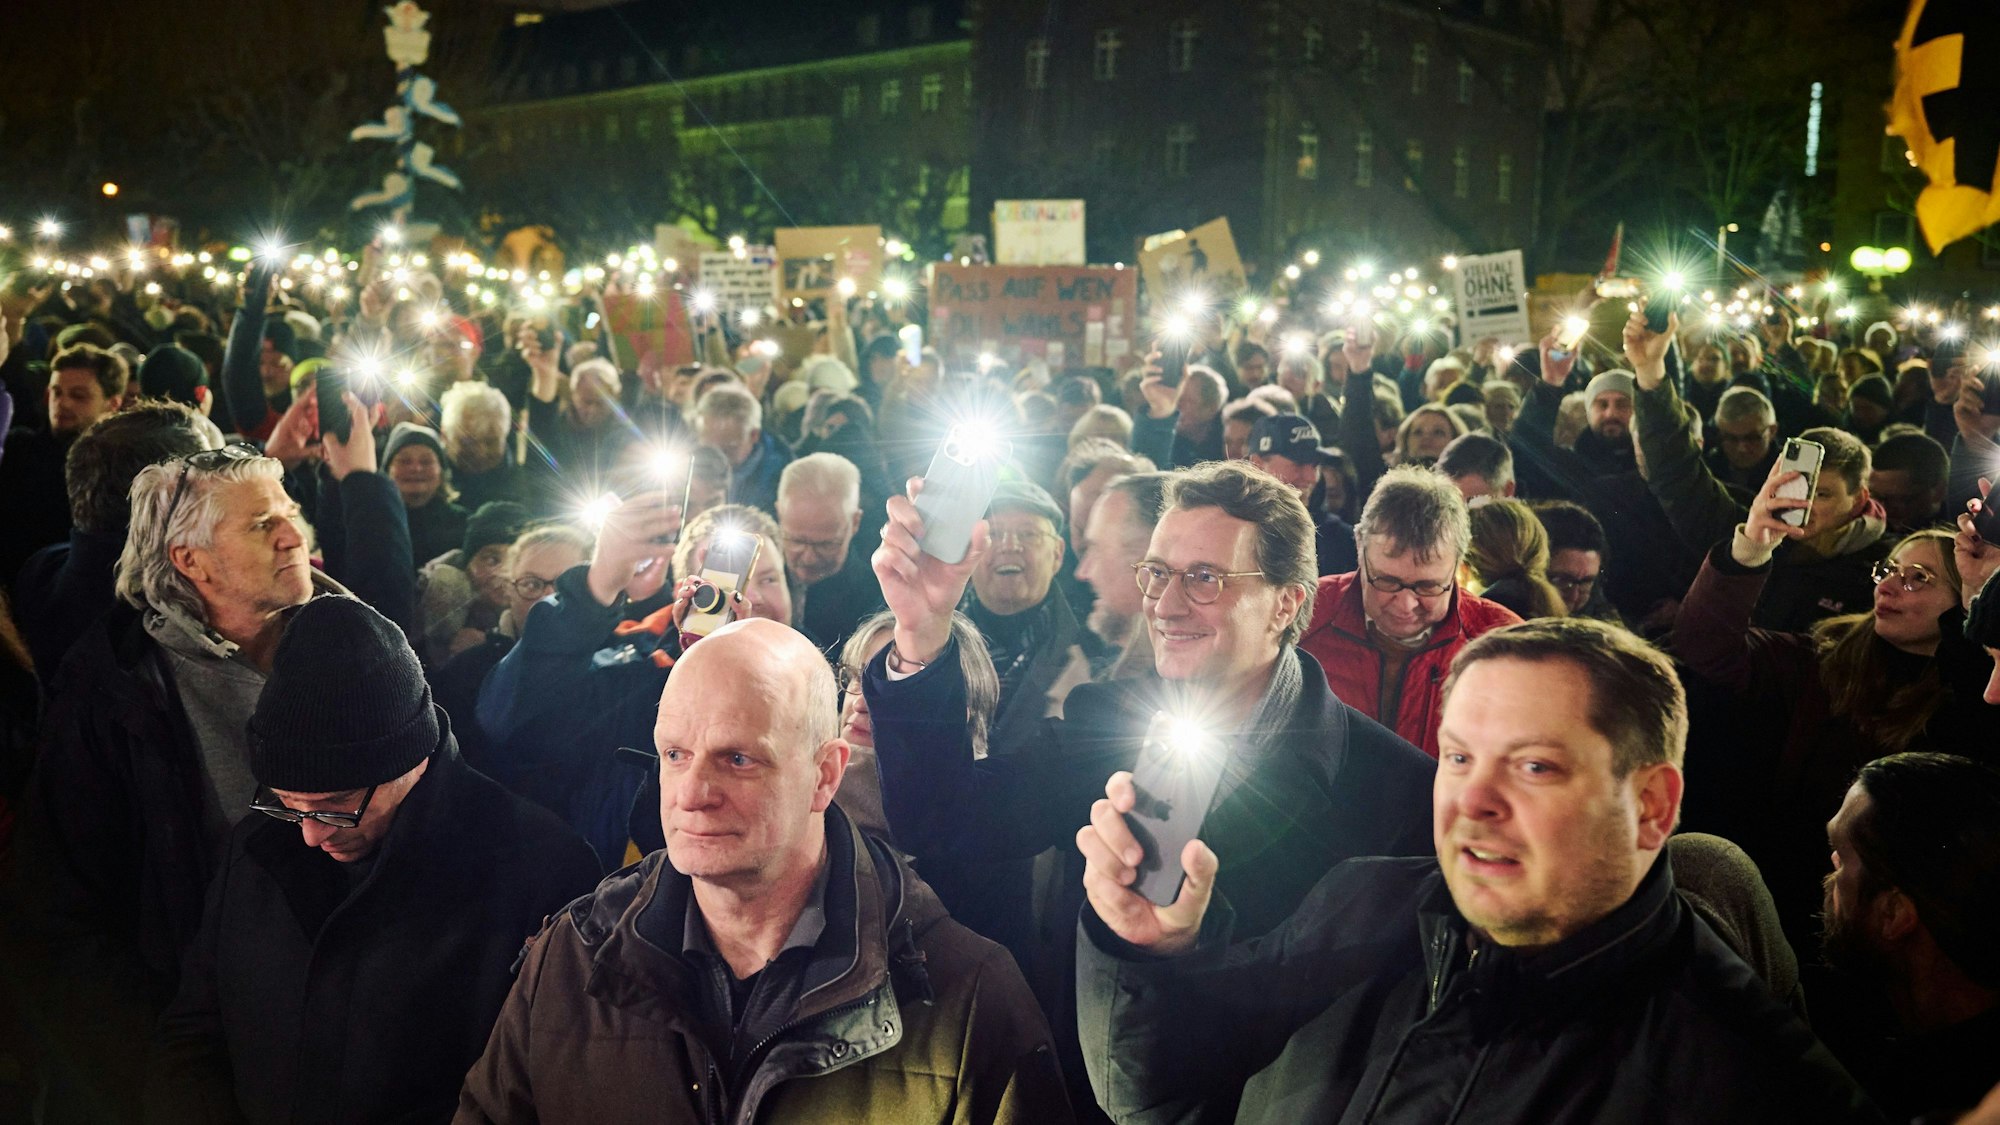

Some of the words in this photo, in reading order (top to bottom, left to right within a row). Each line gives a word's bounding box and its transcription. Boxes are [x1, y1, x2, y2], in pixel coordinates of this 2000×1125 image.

[1462, 260, 1513, 277] VIELFALT
[1056, 277, 1115, 301] WEN
[1464, 276, 1515, 297] OHNE
